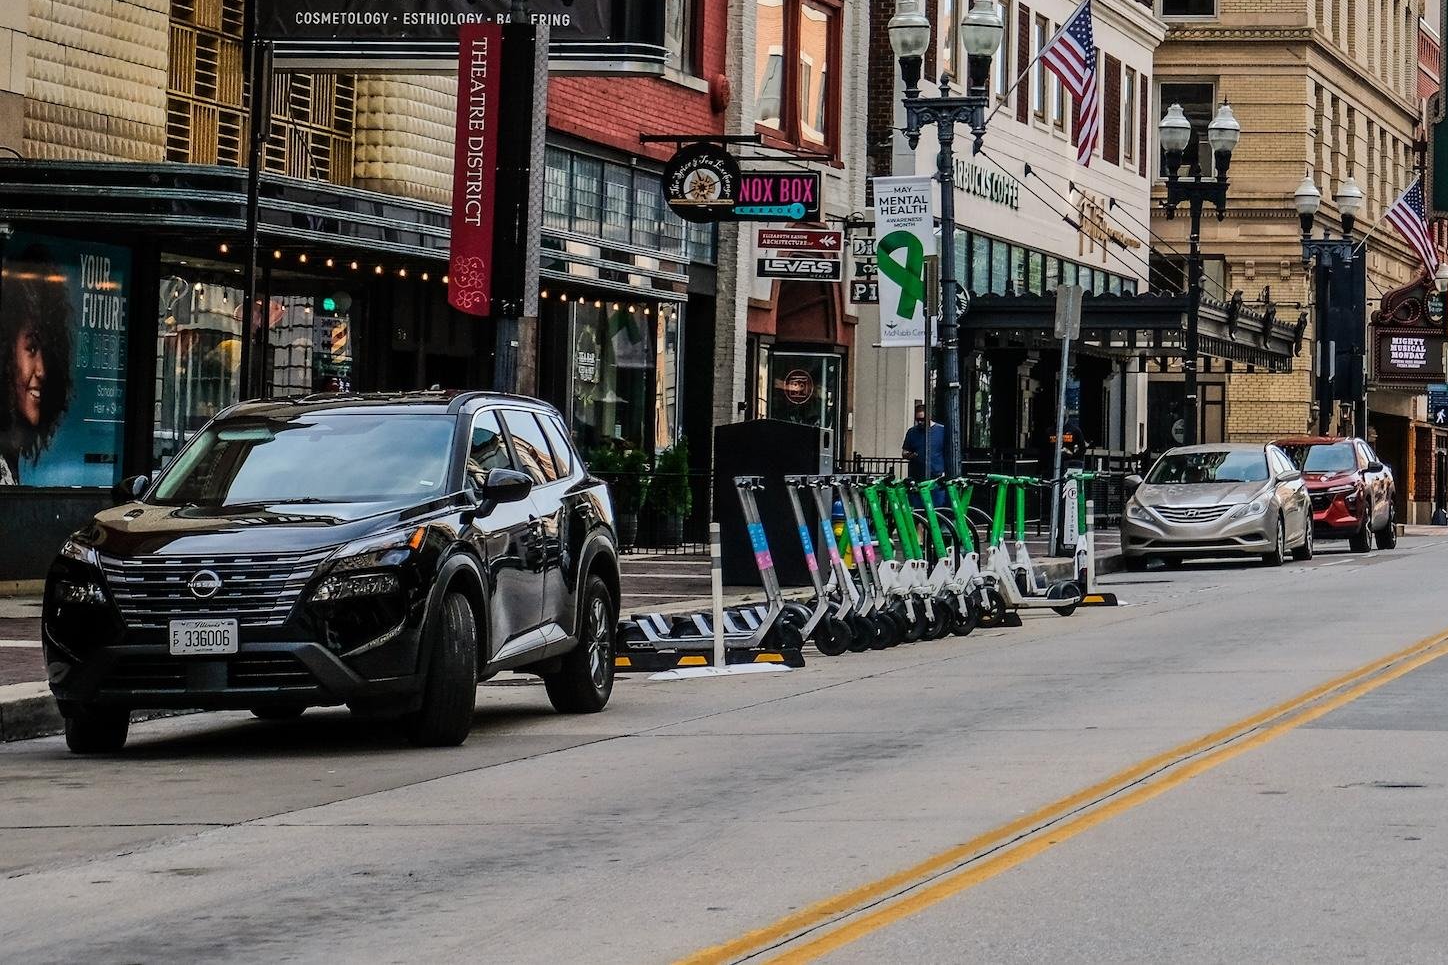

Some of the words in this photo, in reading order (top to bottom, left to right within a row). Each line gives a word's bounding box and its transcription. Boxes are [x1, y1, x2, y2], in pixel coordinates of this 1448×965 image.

[295, 12, 389, 26] COSMETOLOGY
[403, 12, 484, 26] ESTHIOLOGY
[496, 12, 571, 27] BAERING
[468, 37, 488, 131] THEATRE
[465, 135, 484, 227] DISTRICT
[739, 178, 773, 202] NOX
[779, 178, 813, 202] BOX
[879, 195, 928, 205] MENTAL
[881, 205, 927, 215] HEALTH
[80, 253, 111, 290] YOUR
[764, 259, 833, 273] LEVELS
[82, 292, 127, 332] FUTURE
[1390, 344, 1426, 352] MUSICAL
[1391, 337, 1425, 345] MIGHTY
[1391, 351, 1425, 359] MONDAY
[187, 580, 222, 588] NISSAN
[184, 629, 230, 647] 336006
